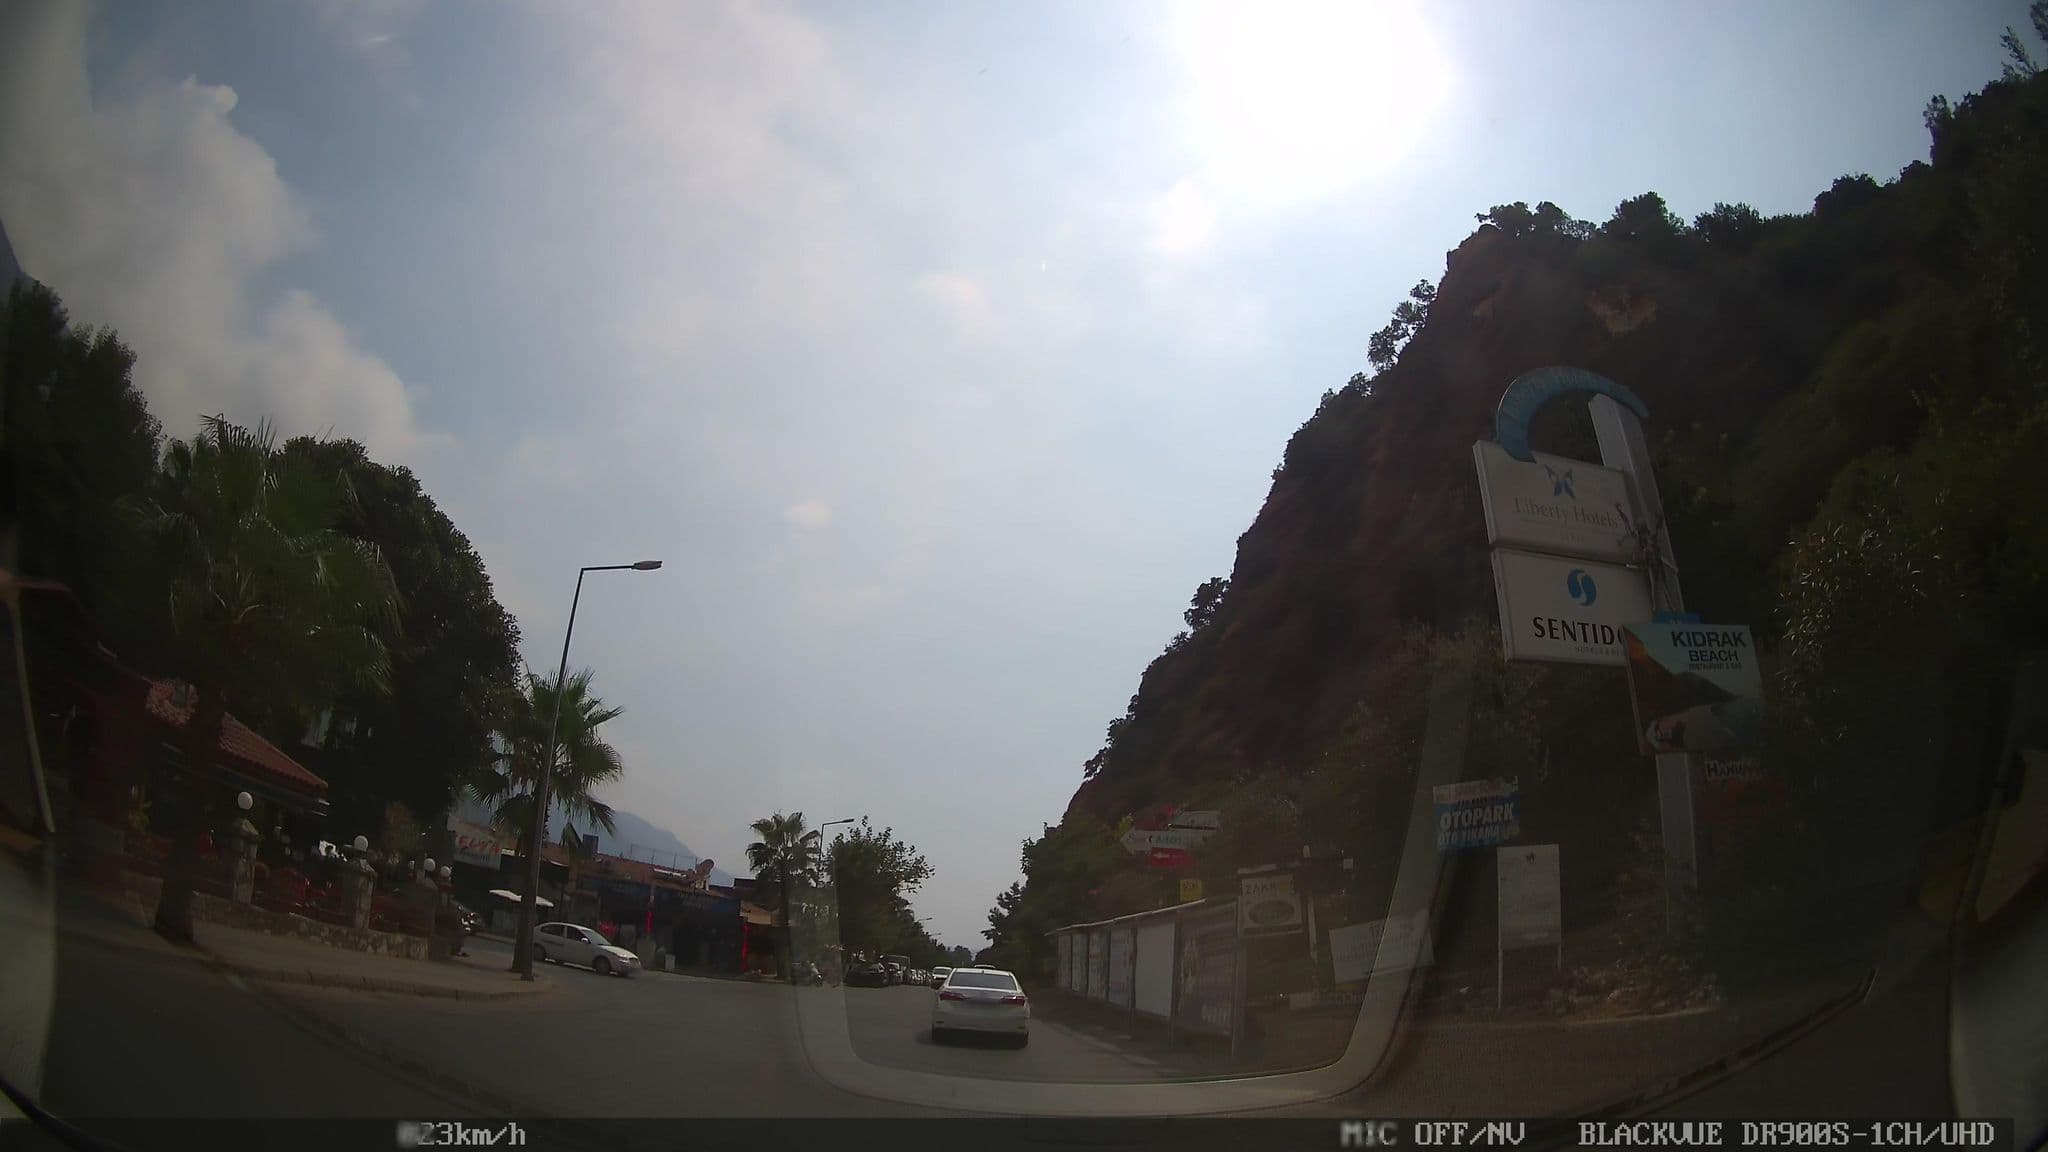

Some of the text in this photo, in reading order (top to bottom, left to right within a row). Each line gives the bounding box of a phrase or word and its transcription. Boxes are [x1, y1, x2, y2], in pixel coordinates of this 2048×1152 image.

[1513, 496, 1619, 529] Liberty Hotels
[1671, 631, 1747, 648] KIDRAK
[1688, 649, 1739, 662] BEACH
[1439, 802, 1514, 828] OTOPARK
